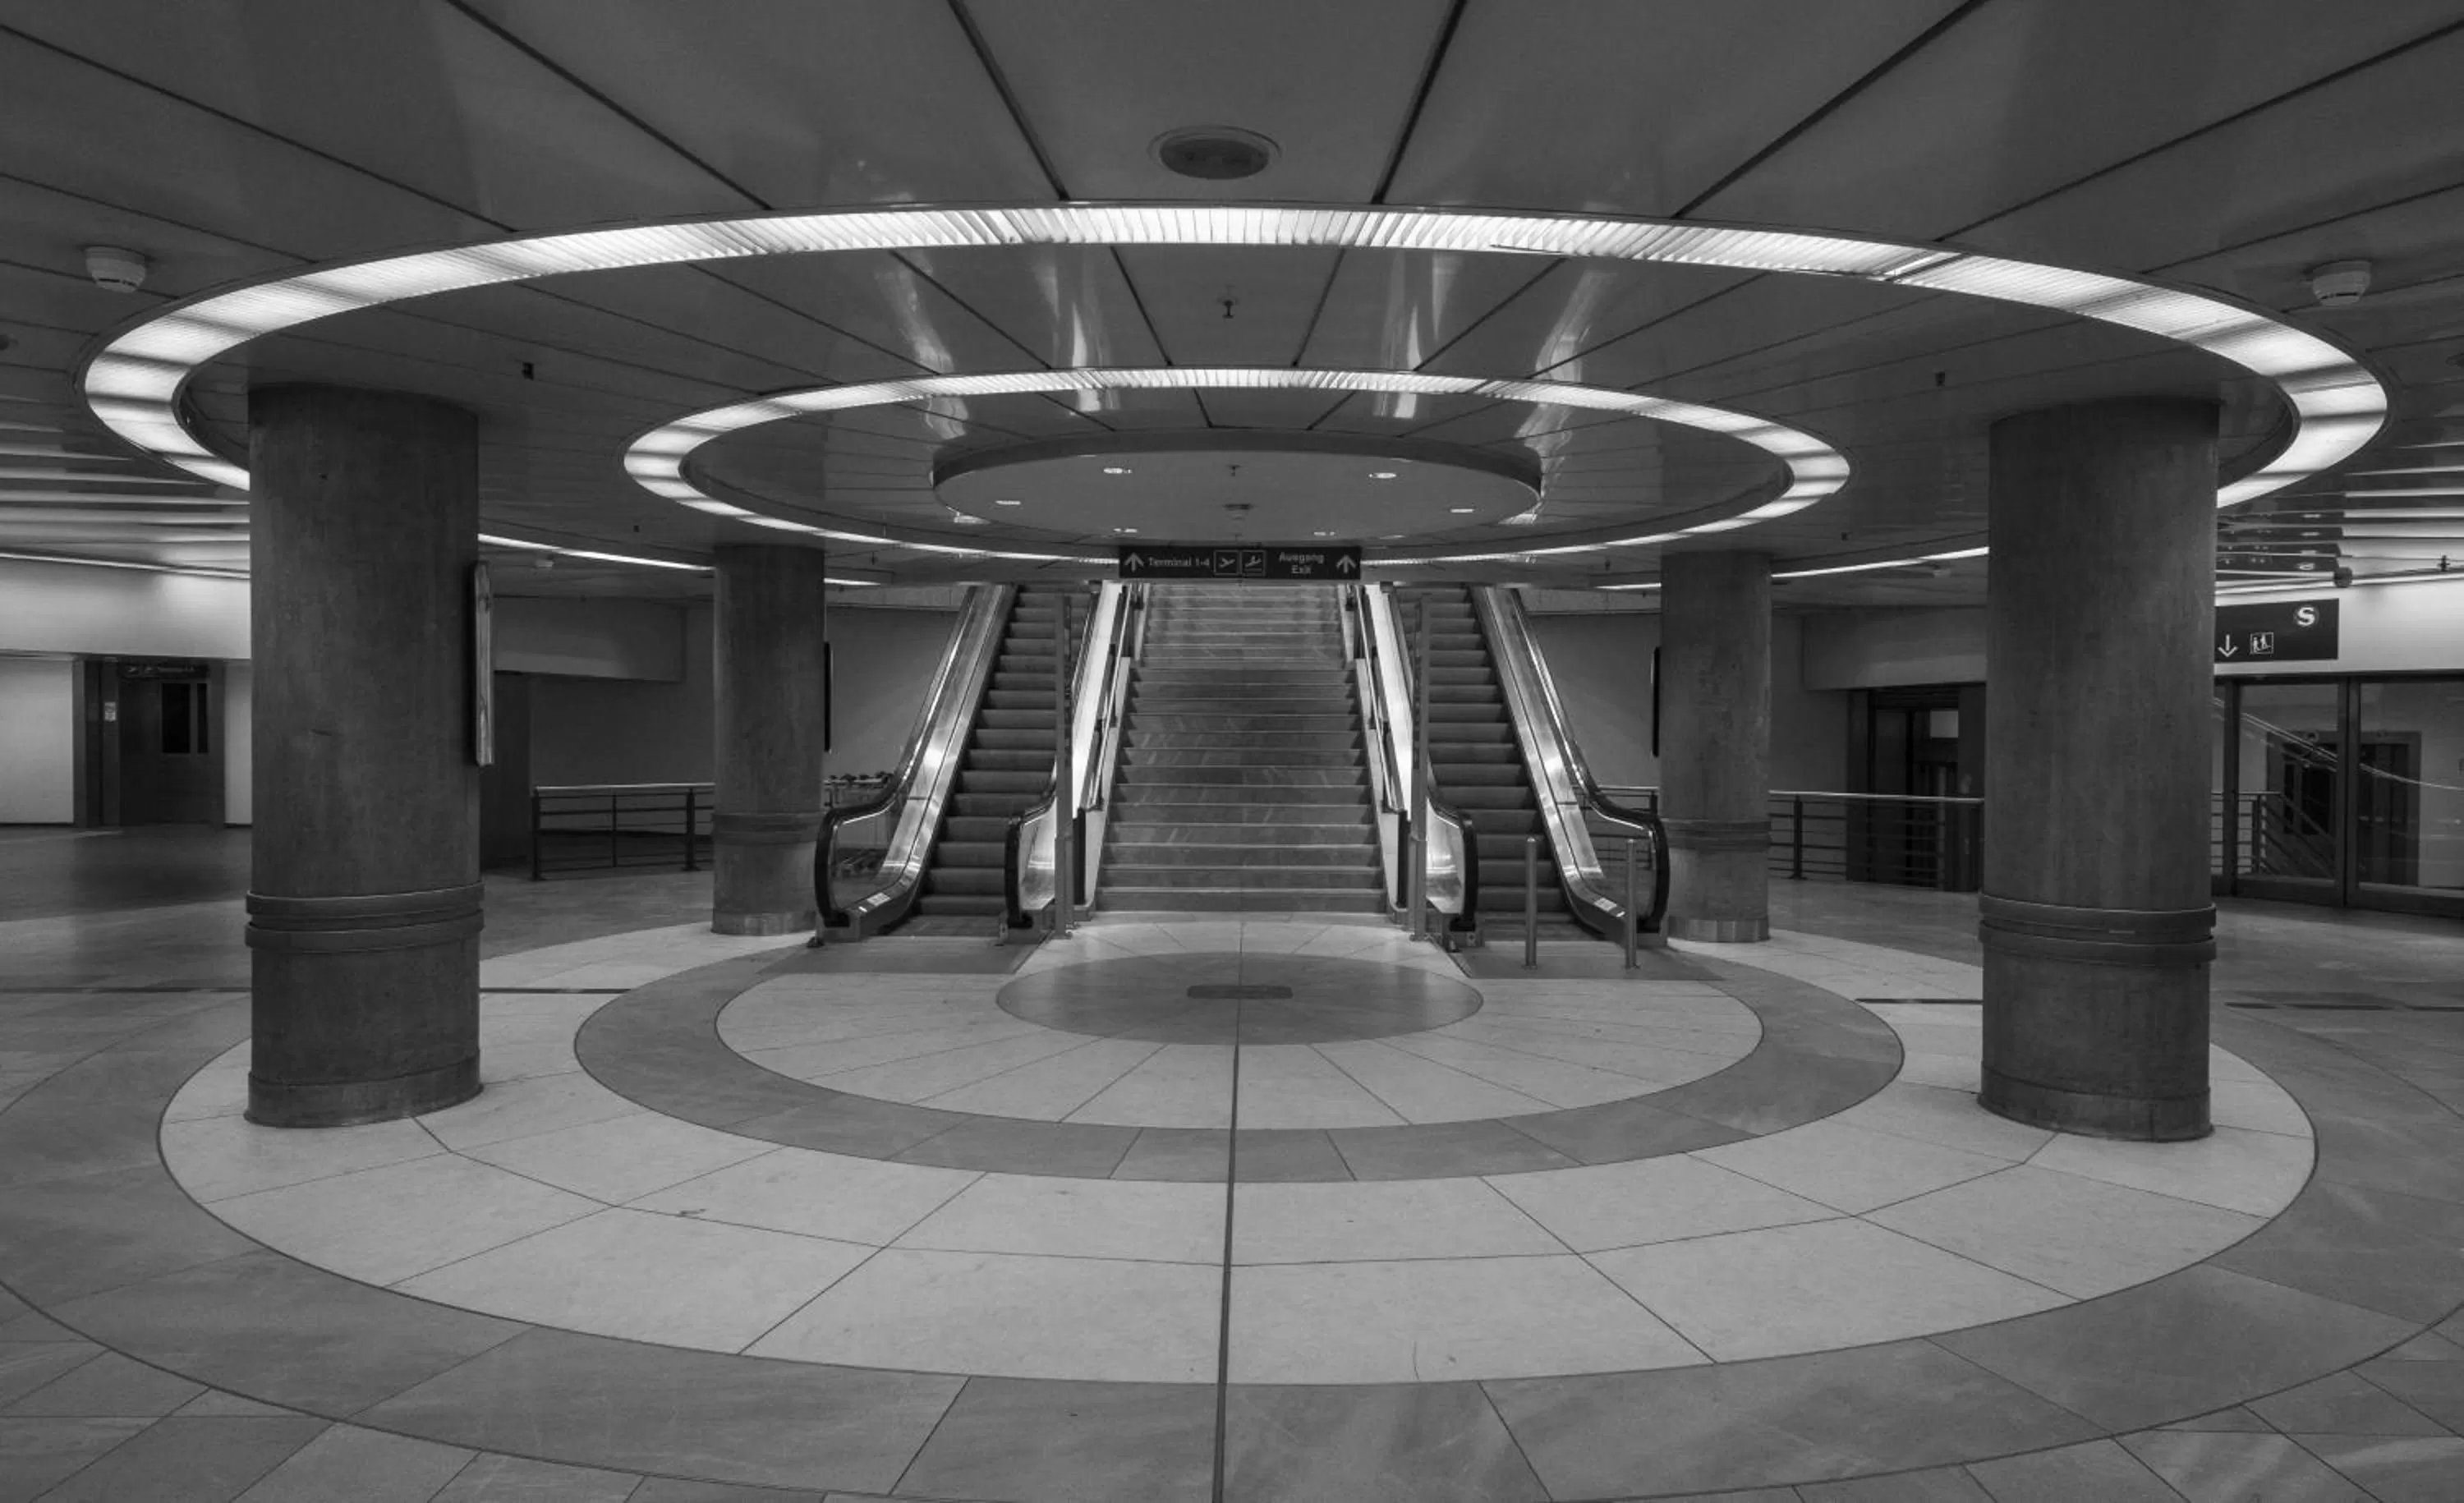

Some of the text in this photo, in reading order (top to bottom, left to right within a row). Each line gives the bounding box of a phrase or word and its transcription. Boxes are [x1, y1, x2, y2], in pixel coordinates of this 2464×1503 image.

[1149, 557, 1192, 567] Terminal
[1280, 551, 1325, 564] Ausgang
[1291, 565, 1312, 574] Exit
[2296, 606, 2315, 627] S
